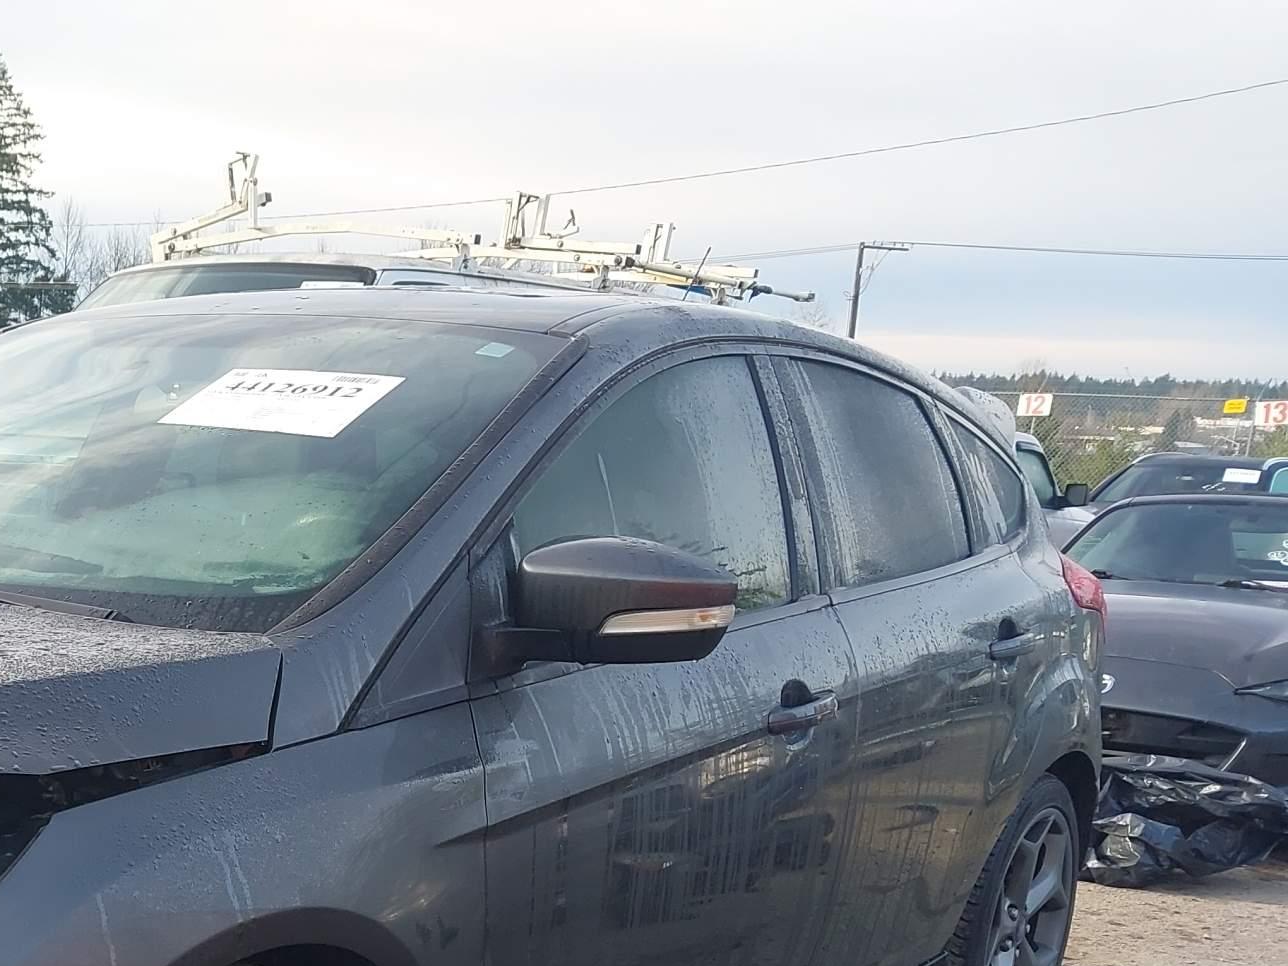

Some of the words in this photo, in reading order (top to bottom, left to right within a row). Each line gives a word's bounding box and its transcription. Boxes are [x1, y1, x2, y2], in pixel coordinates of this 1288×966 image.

[225, 381, 364, 398] 44126912
[1024, 395, 1046, 415] 12
[1263, 401, 1288, 424] 13
